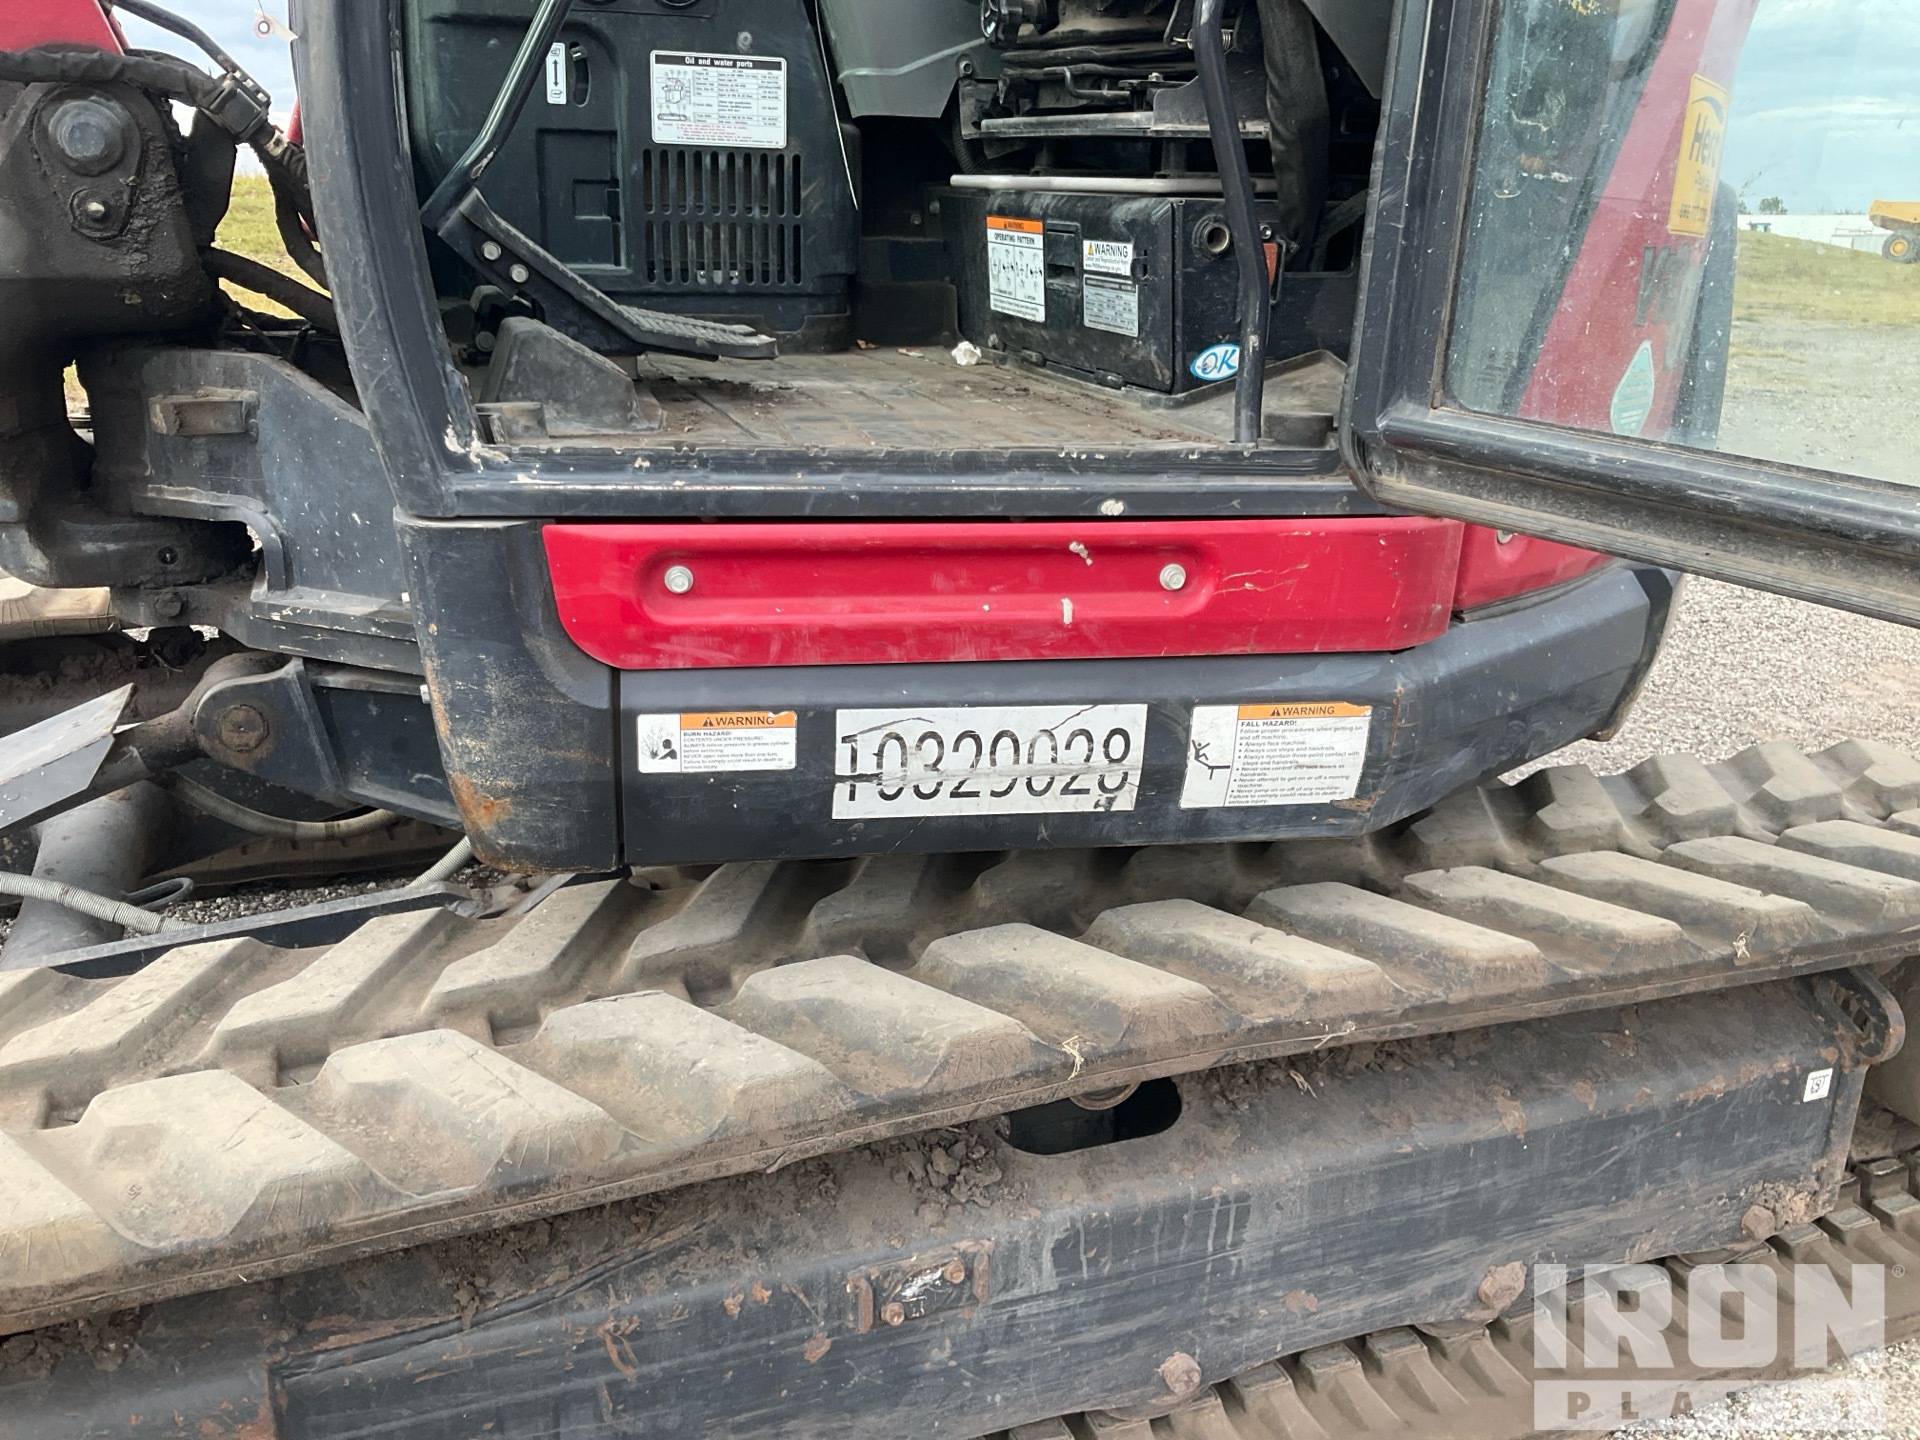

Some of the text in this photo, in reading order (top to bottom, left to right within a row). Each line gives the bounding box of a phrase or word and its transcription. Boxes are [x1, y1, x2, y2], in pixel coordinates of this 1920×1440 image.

[1007, 221, 1024, 230] WARNING
[994, 233, 1035, 245] OPERATING PATTERN
[1094, 243, 1128, 258] WARNING
[1282, 707, 1335, 716] WARNING
[716, 716, 775, 726] WARNING
